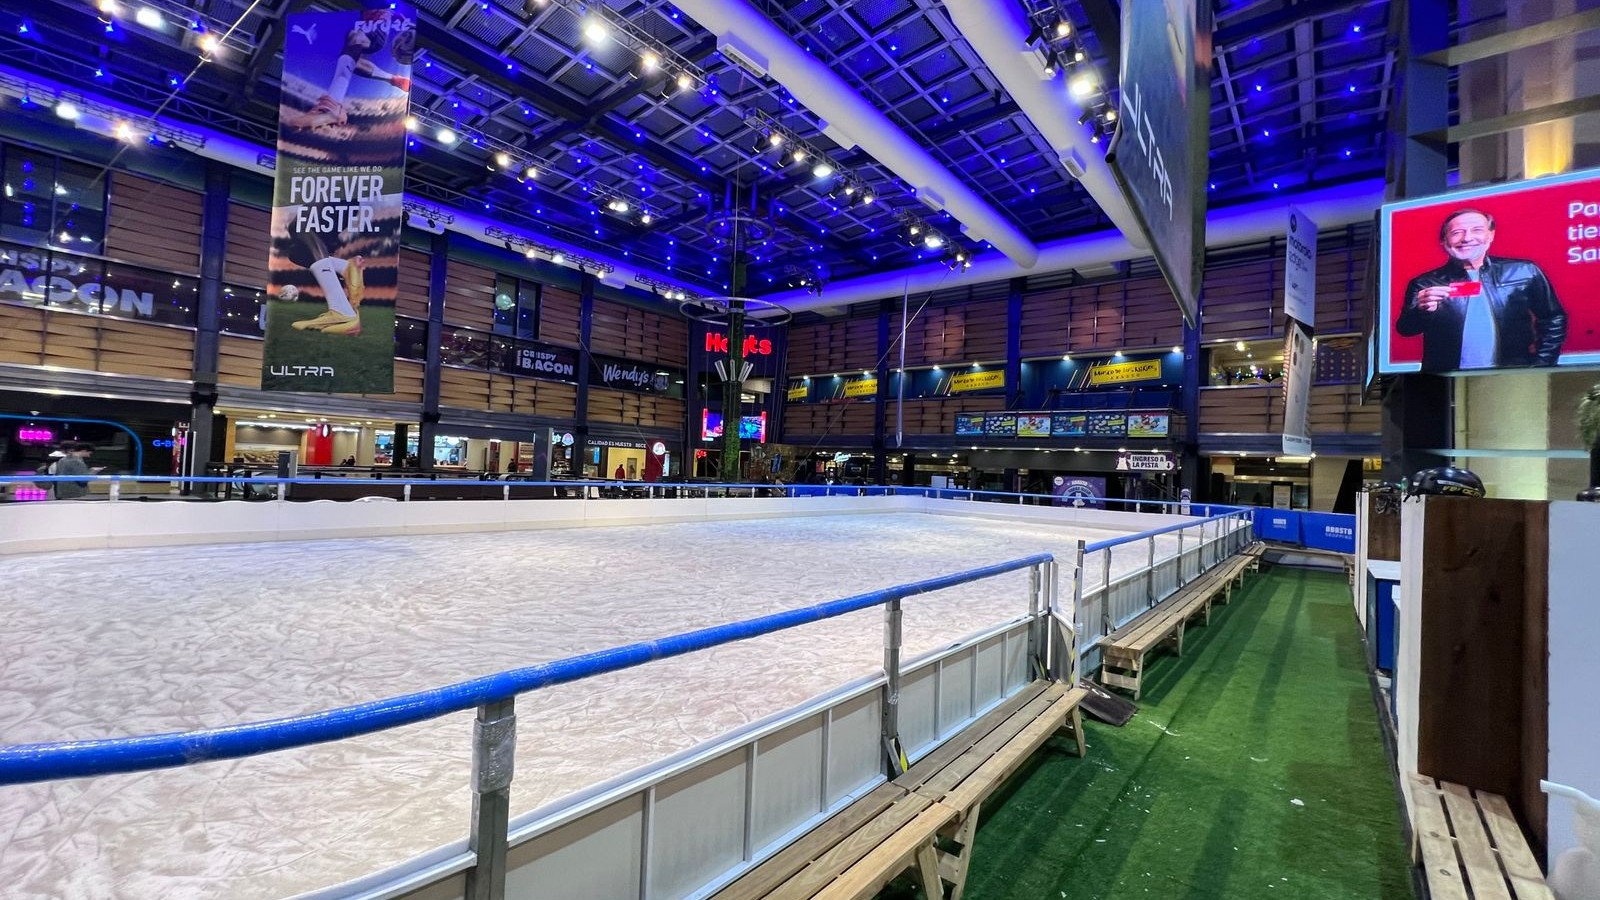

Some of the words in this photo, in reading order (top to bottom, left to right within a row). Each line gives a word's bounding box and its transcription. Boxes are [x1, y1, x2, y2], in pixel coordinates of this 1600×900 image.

[290, 175, 384, 203] FOREVER
[295, 205, 380, 233] FASTER.
[1567, 202, 1600, 219] Pa
[1567, 223, 1600, 241] tie
[1567, 246, 1600, 263] Sa
[270, 365, 334, 377] ULTRA
[521, 357, 573, 376] BACON
[603, 363, 649, 387] Wendy's
[1132, 455, 1159, 463] INGRESO
